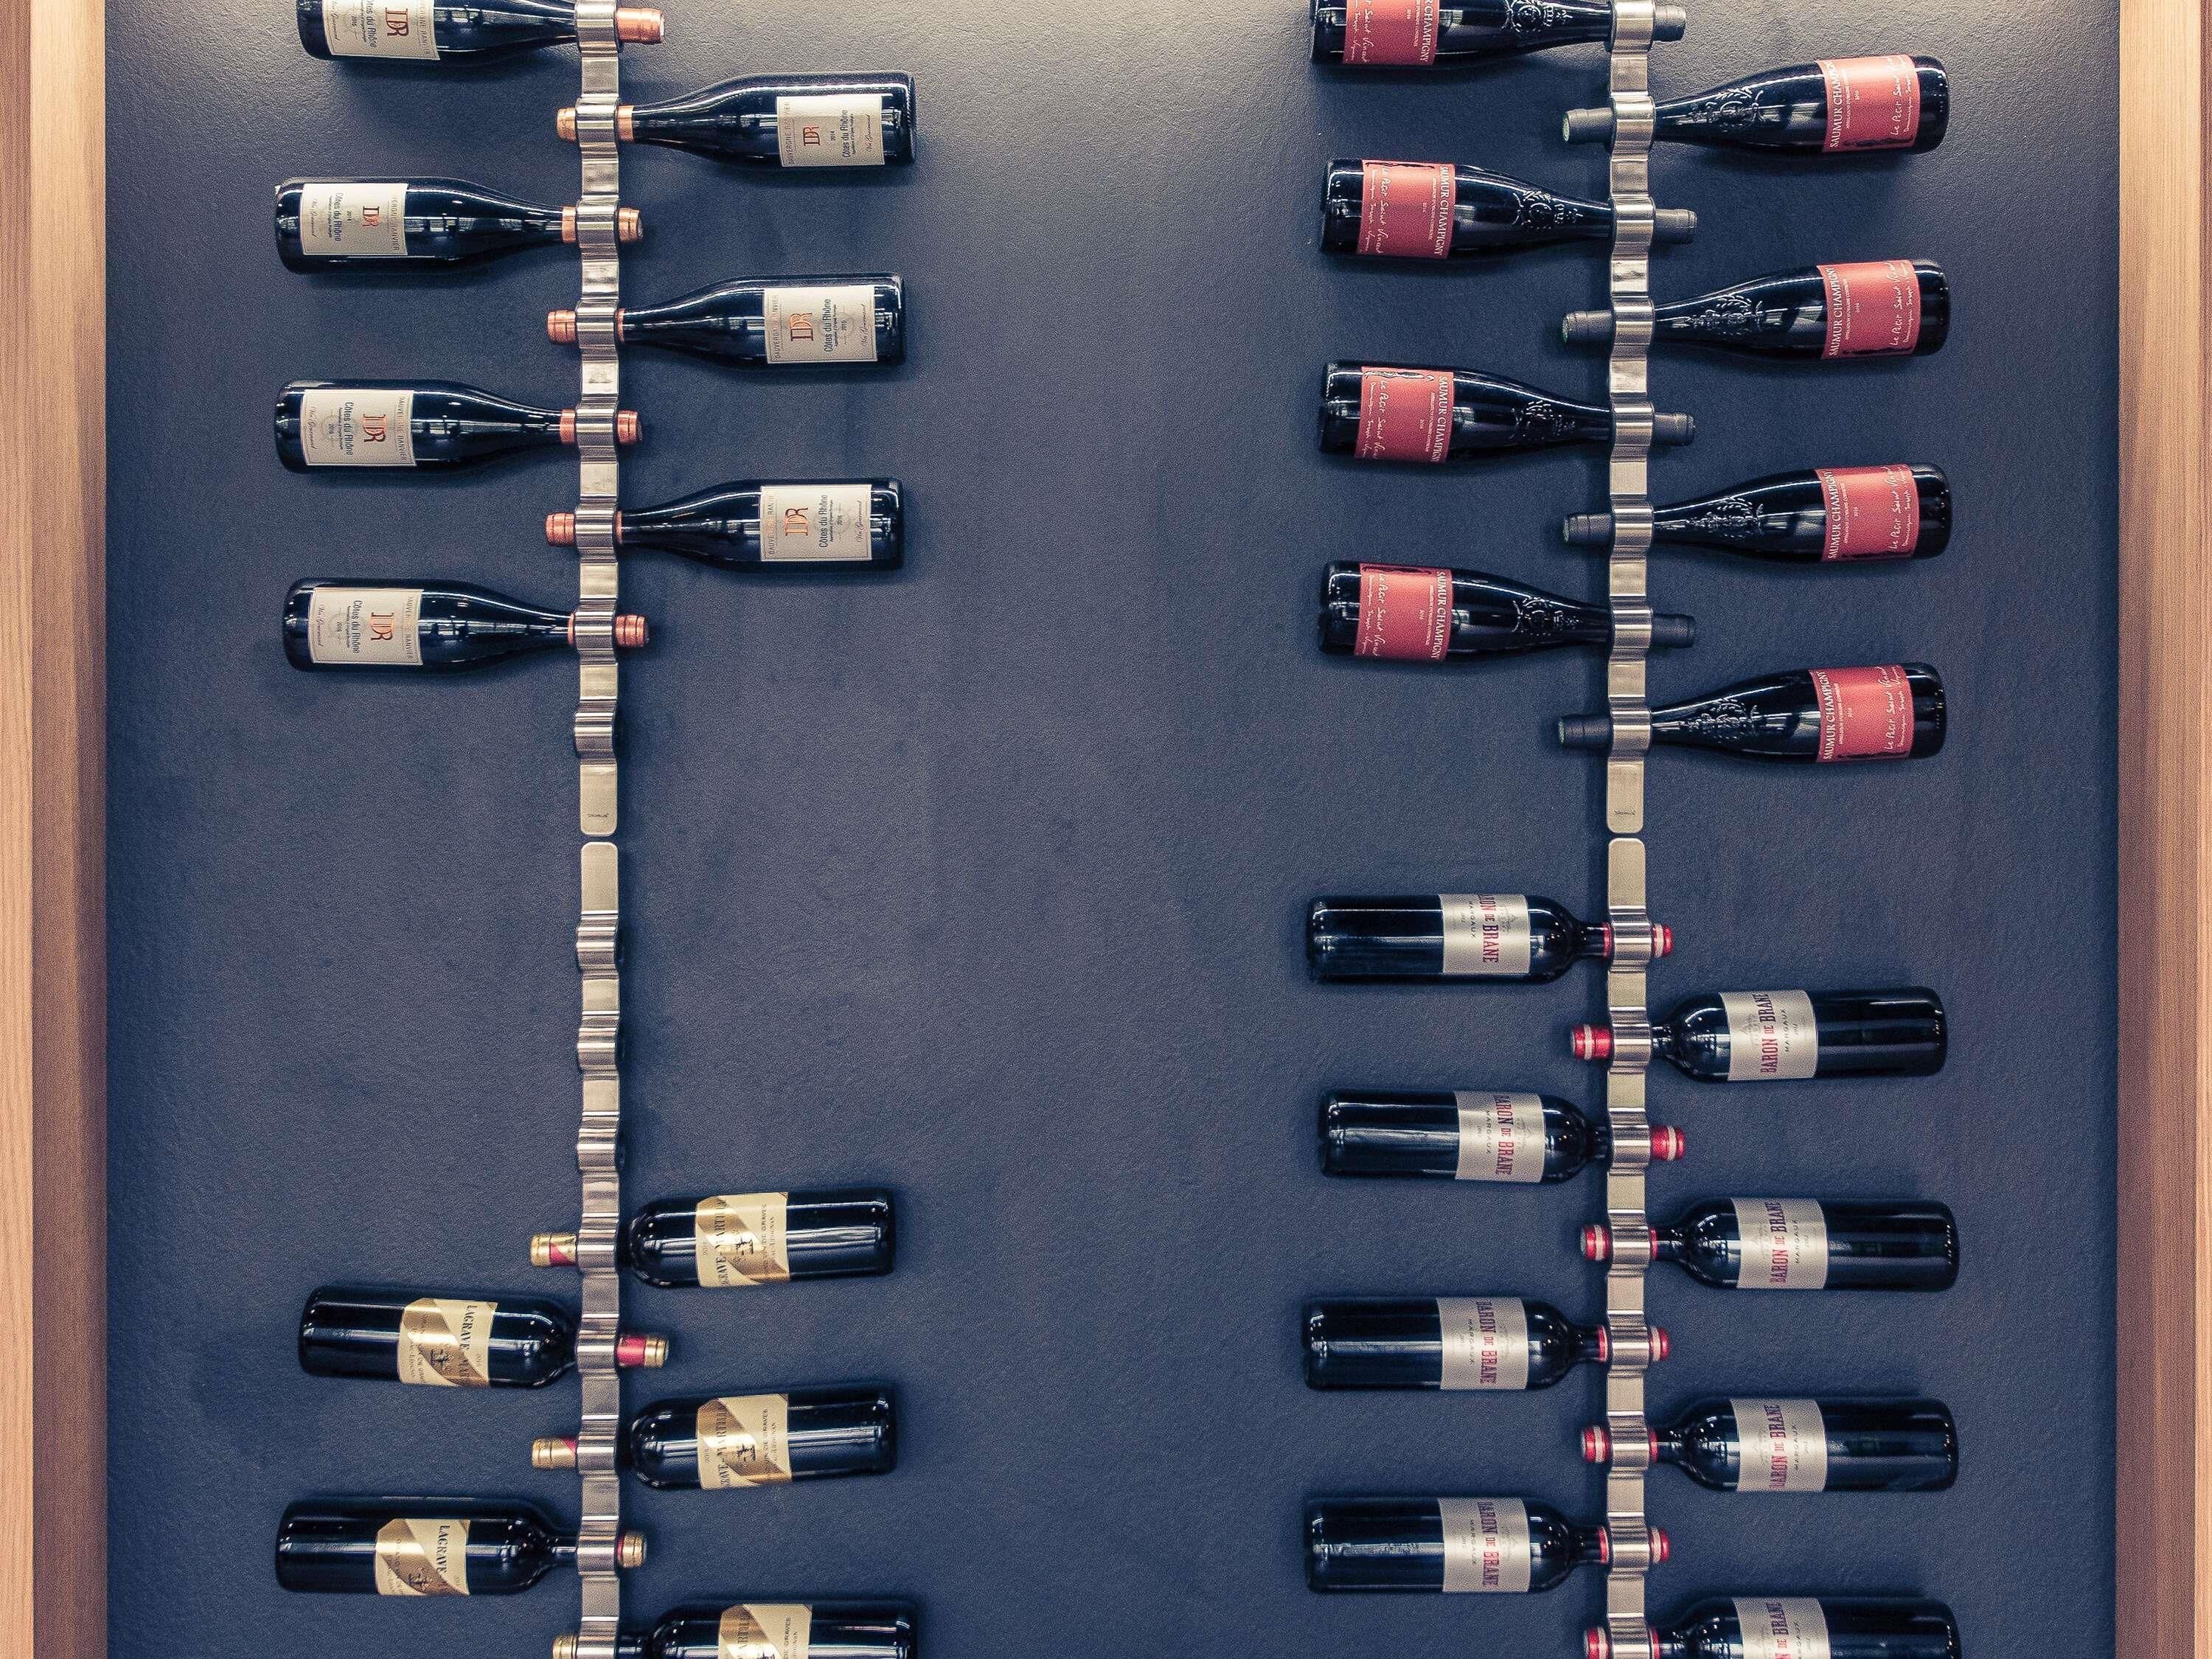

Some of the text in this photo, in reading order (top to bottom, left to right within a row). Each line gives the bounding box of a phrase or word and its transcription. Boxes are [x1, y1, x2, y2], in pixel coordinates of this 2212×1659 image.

[366, 16, 375, 26] du
[1364, 9, 1373, 34] Saint
[1419, 7, 1433, 62] CHAMPIGNY
[367, 27, 378, 47] Rhône
[840, 111, 848, 131] Rhône
[1893, 102, 1902, 121] Petit
[1830, 108, 1842, 147] SAUMUR
[1891, 124, 1899, 135] Le
[841, 142, 850, 157] Côtes
[1381, 178, 1391, 196] Petit
[1380, 201, 1388, 225] Saint
[1434, 167, 1449, 255] SAUMUR CHAMPIGNY
[334, 221, 344, 241] Rhône
[1825, 267, 1843, 355] SAUMUR CHAMPIGNY
[1891, 286, 1902, 309] Saint
[822, 299, 832, 352] Côtes du Rhône
[1891, 314, 1901, 333] Petit
[1890, 336, 1899, 345] Le
[1380, 393, 1389, 412] Petit
[1438, 376, 1447, 414] SAUMUR
[344, 402, 354, 455] Côtes du Rhône
[1377, 419, 1386, 439] Saint
[1823, 470, 1841, 559] SAUMUR CHAMPIGNY
[1891, 491, 1902, 513] Saint
[818, 495, 828, 547] Côtes du Rhône
[1891, 518, 1901, 537] Petit
[1890, 540, 1898, 549] Le
[1378, 584, 1388, 603] Petit
[352, 600, 363, 653] Côtes du Rhône
[1377, 607, 1385, 630] Saint
[1431, 571, 1446, 659] SAUMUR CHAMPIGNY
[1817, 672, 1835, 759] SAUMUR CHAMPIGNY
[1885, 692, 1896, 714] Saint
[1886, 720, 1895, 738] Petit
[1482, 925, 1498, 962] BRANE
[1752, 994, 1778, 1073] BARON DE BRANE
[1780, 1009, 1790, 1051] MARGAUX
[1494, 1096, 1514, 1175] BARON DE BRANE
[1764, 1202, 1789, 1283] BARON DE BRANE
[460, 1305, 478, 1350] LAGRAVE
[1476, 1301, 1498, 1383] BARON DE BRANE
[1764, 1405, 1787, 1488] BARON DE BRANE
[437, 1525, 450, 1573] LAGRAVE
[1477, 1501, 1499, 1587] BARON DE BRANE
[1766, 1602, 1789, 1635] BRANE
[1777, 1639, 1787, 1649] DE
